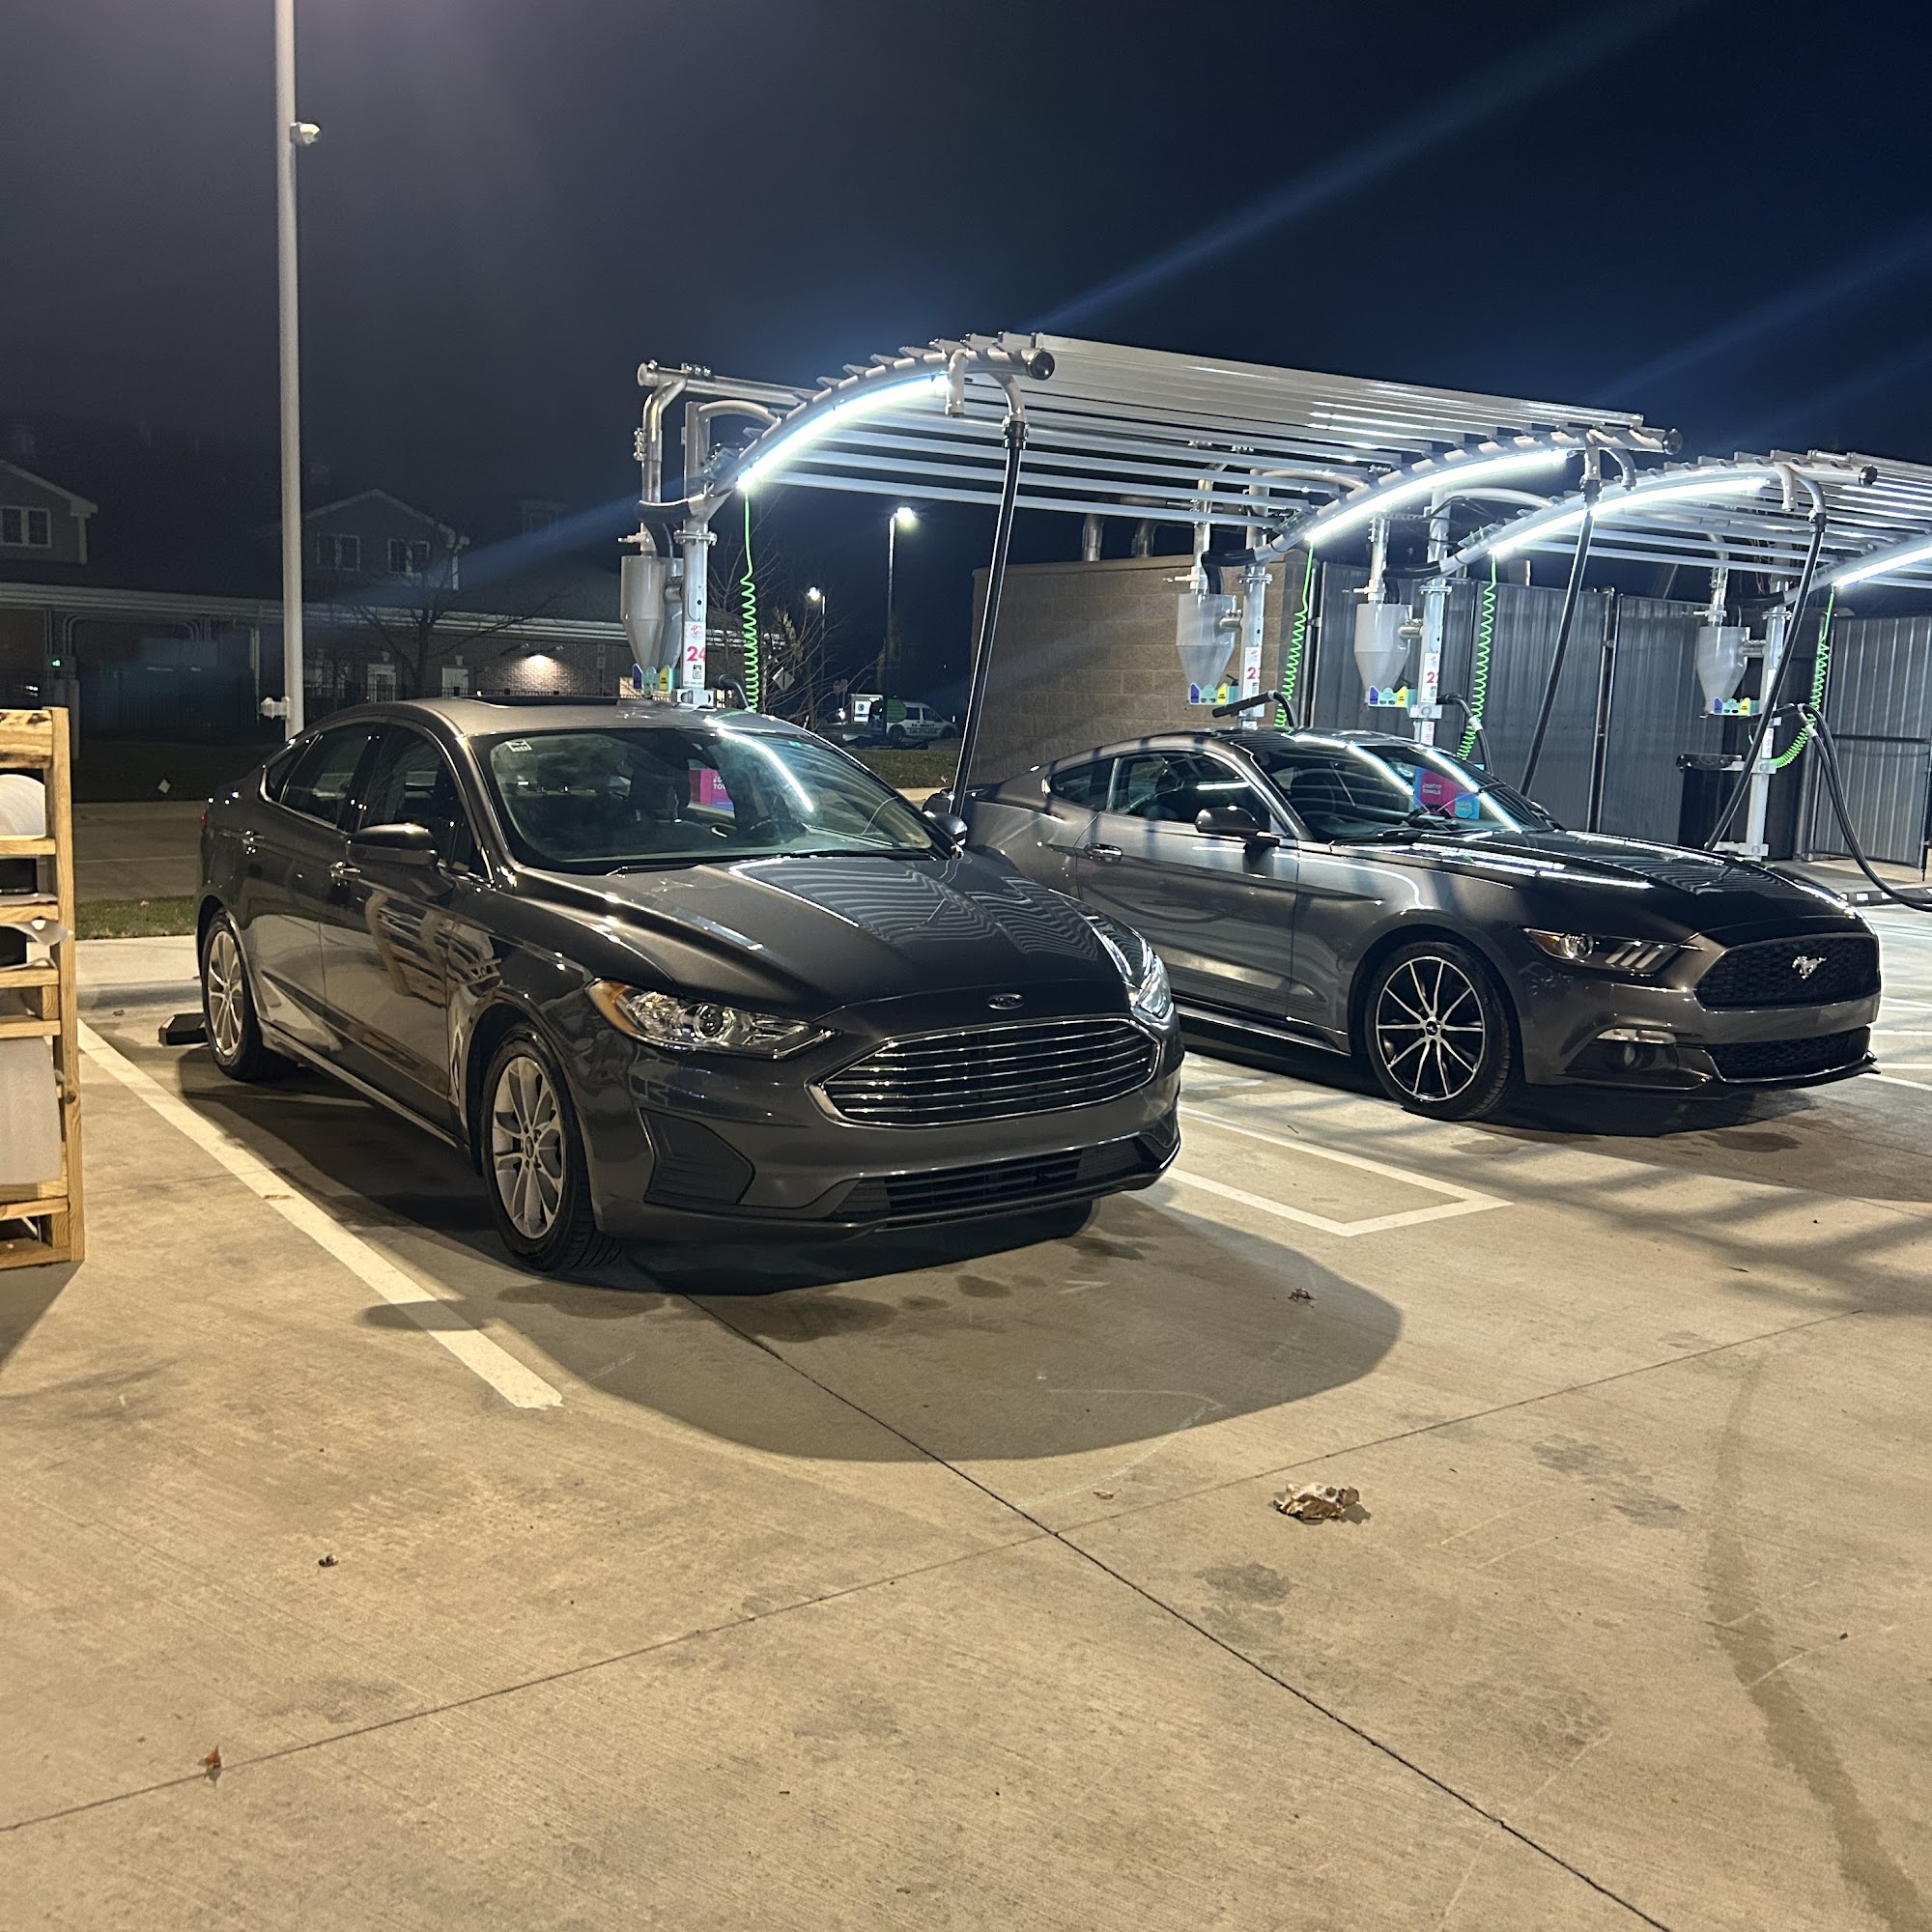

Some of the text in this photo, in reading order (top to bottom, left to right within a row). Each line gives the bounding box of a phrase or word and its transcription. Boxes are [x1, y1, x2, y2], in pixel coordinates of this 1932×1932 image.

[687, 645, 706, 662] 24
[1247, 667, 1261, 680] 2
[1426, 671, 1439, 684] 2
